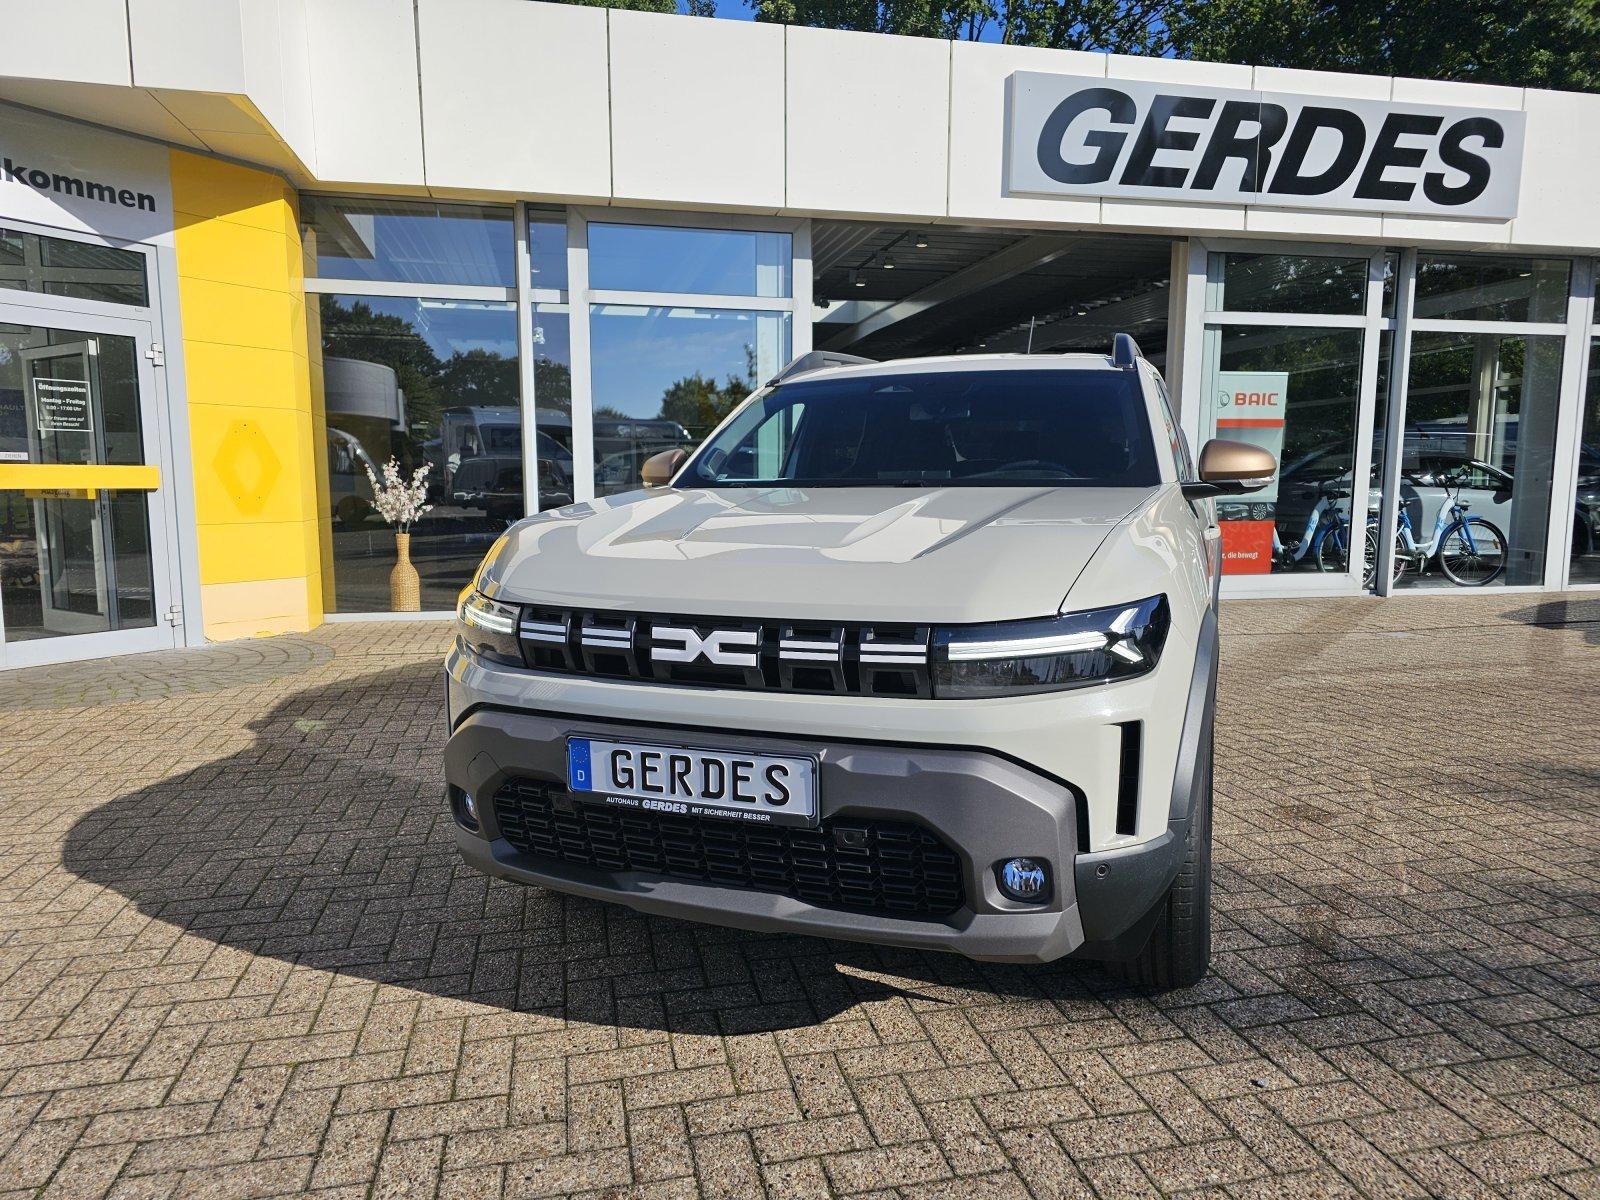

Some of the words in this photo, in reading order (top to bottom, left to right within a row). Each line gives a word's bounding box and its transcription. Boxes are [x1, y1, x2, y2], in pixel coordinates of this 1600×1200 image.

[1037, 87, 1505, 206] GERDES
[0, 158, 156, 212] kommen
[38, 382, 87, 392] Öffnungszeiten
[66, 398, 86, 406] Freitag
[1234, 392, 1279, 406] BAIC
[1227, 551, 1237, 559] die
[1237, 551, 1259, 560] bewegt
[577, 770, 585, 782] D
[610, 749, 790, 806] GERDES
[606, 796, 639, 806] AUTOHAUS
[641, 799, 688, 814] GERDES
[691, 806, 702, 814] MIT
[703, 807, 742, 819] SICHERHEIT
[743, 812, 771, 822] BESSER
